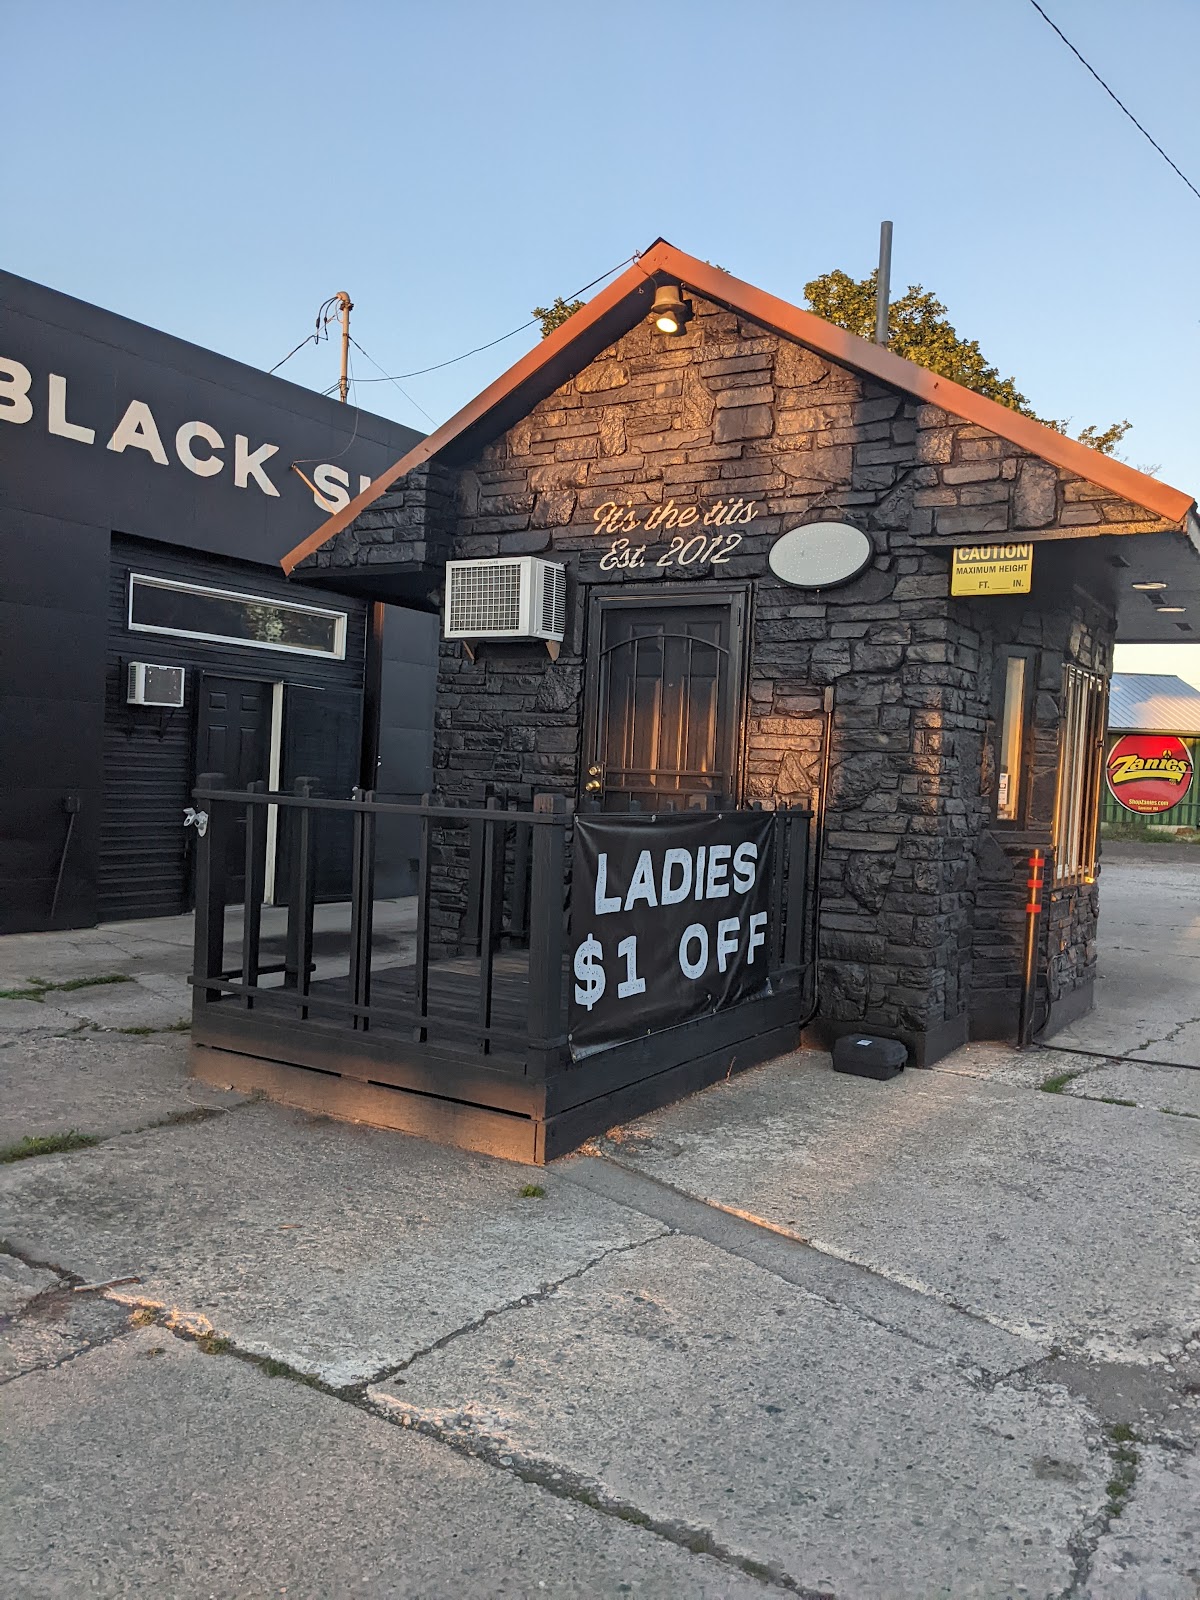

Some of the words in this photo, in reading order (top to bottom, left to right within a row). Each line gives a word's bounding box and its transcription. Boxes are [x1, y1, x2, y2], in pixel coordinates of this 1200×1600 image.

[0, 356, 281, 497] BLACK
[593, 500, 641, 535] It's
[643, 499, 700, 532] the
[703, 497, 759, 527] tits
[599, 538, 647, 571] Est.
[656, 533, 743, 568] 2012
[956, 565, 997, 575] MAXIMUM
[998, 564, 1028, 573] HEIGHT
[958, 543, 1028, 561] CAUTION
[978, 580, 990, 589] FT.
[1012, 579, 1024, 588] IN.
[1110, 751, 1189, 784] Zanies
[595, 841, 758, 915] LADIES
[573, 933, 646, 1011] $1
[678, 911, 768, 980] OFF
